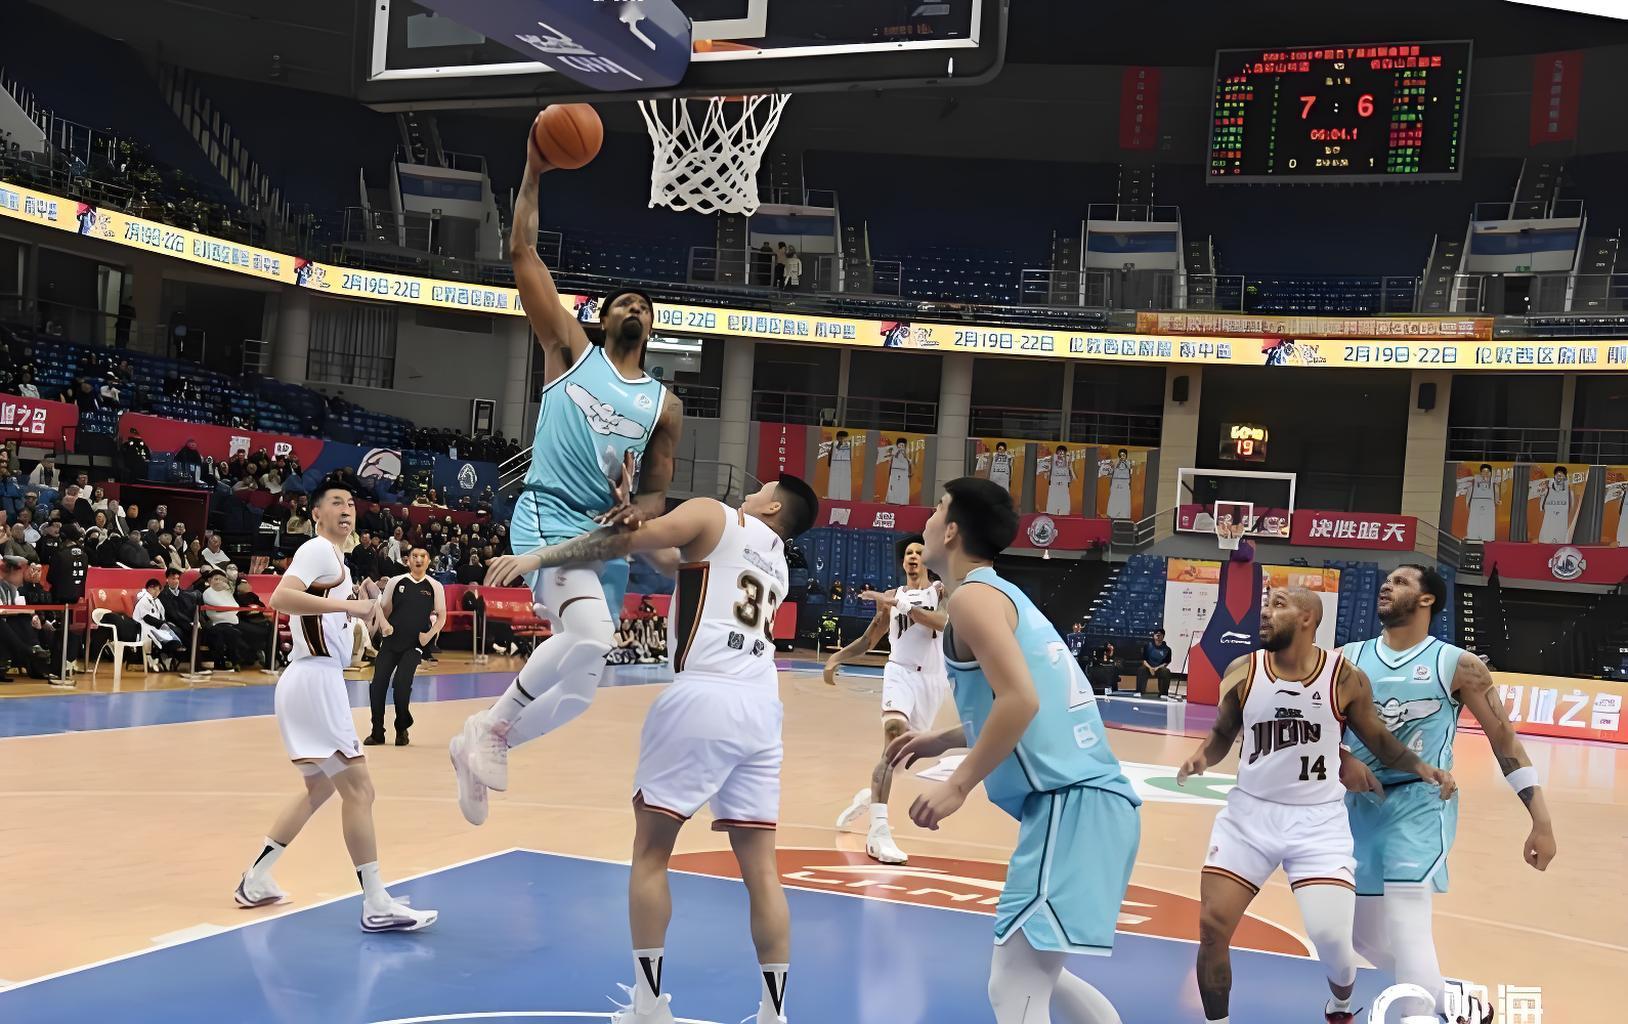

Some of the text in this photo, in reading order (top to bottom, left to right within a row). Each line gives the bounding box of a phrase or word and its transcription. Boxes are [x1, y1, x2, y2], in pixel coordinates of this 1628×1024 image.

[1299, 95, 1317, 119] 7
[1357, 93, 1374, 117] 6
[954, 331, 1054, 351] 2月19日-22日
[1343, 346, 1457, 363] 2月19日-22日
[1236, 439, 1254, 456] 19
[1299, 754, 1327, 780] 14
